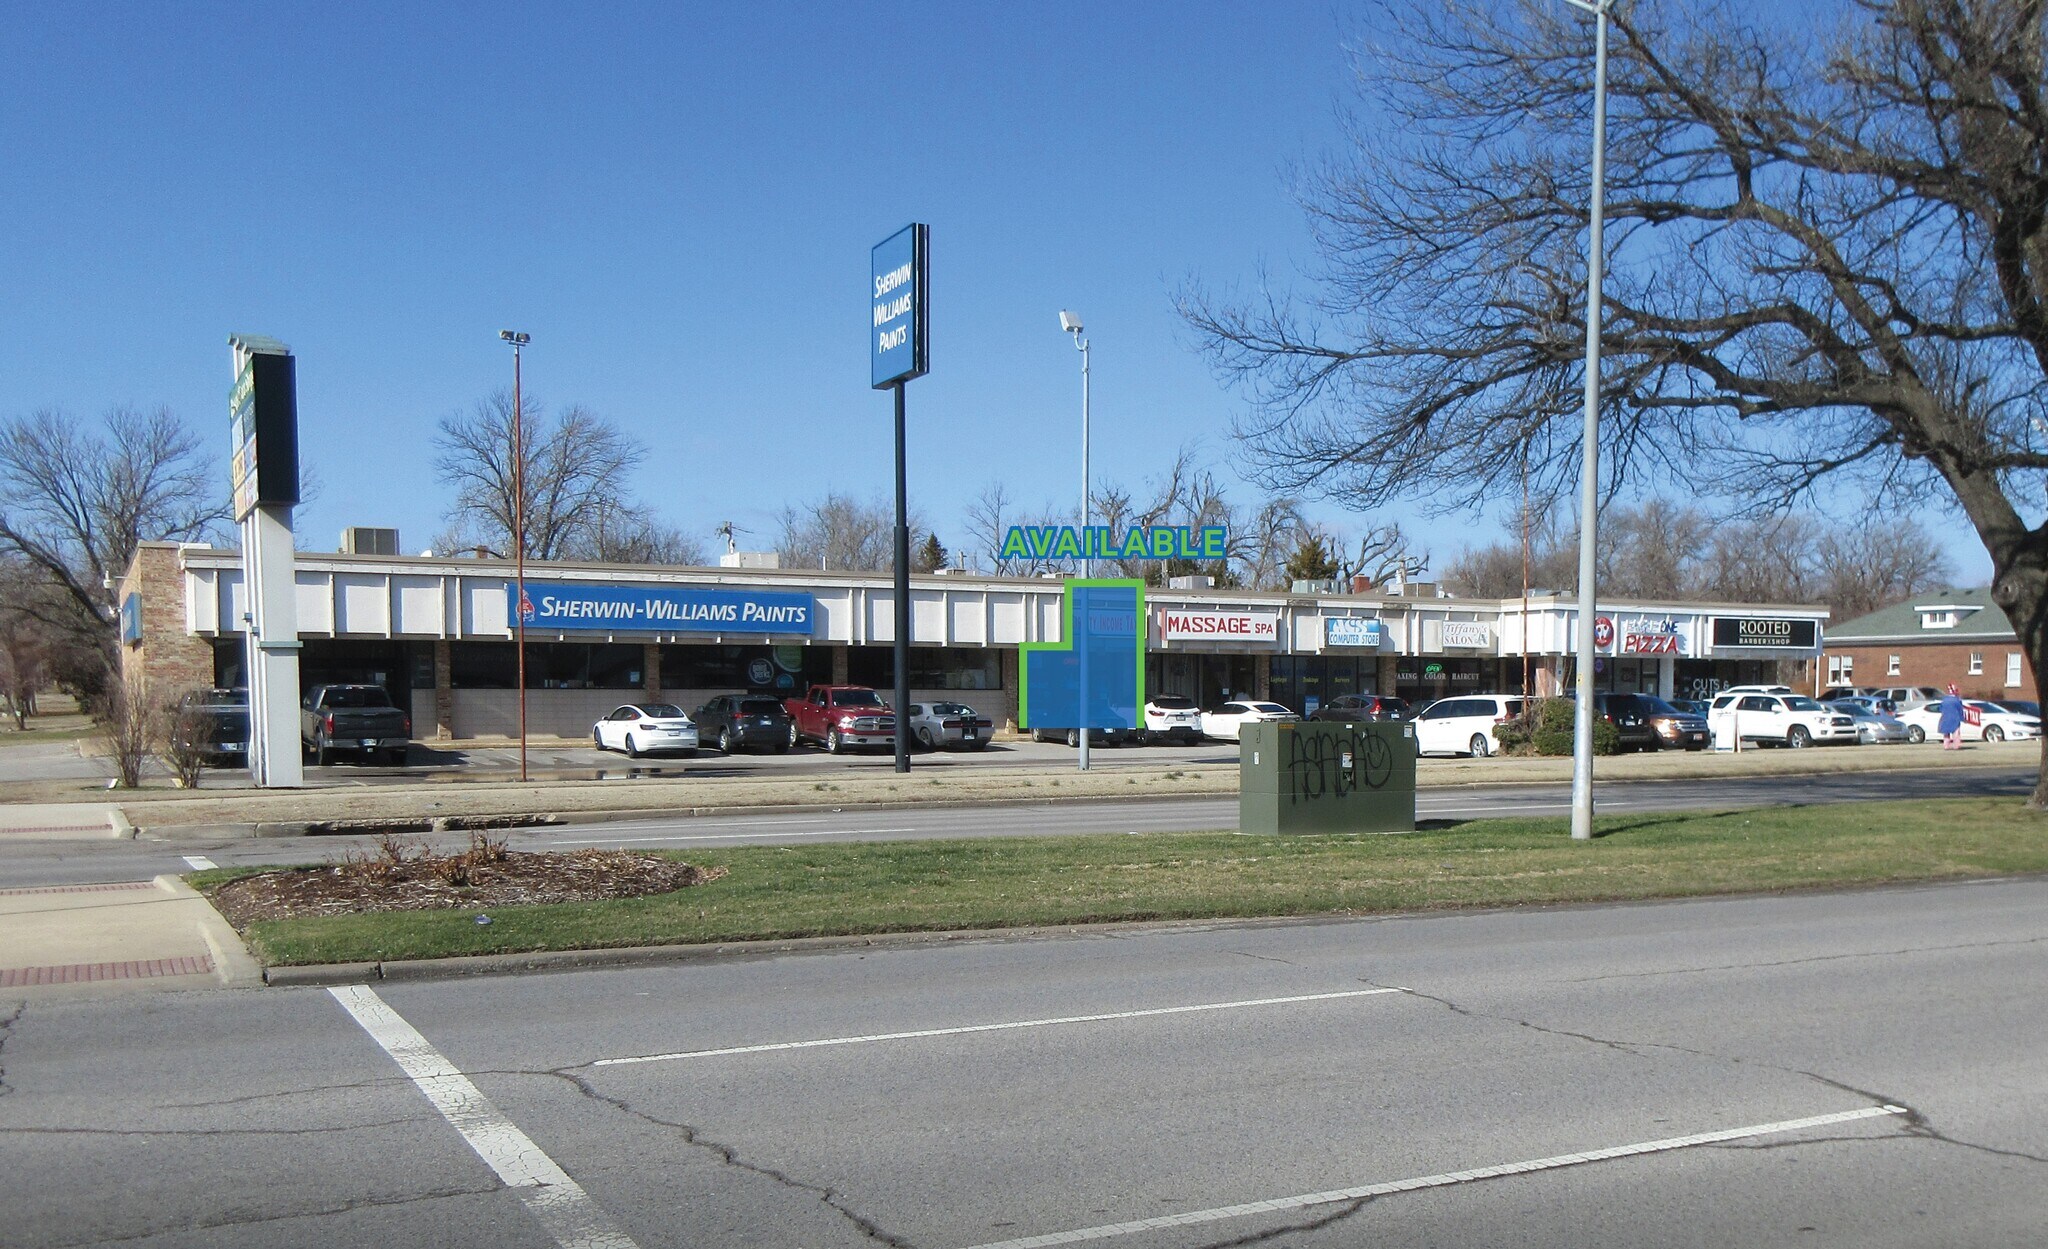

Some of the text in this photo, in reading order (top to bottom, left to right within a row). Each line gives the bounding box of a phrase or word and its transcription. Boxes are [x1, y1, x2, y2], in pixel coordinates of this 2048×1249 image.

[874, 262, 912, 298] SHERWIN
[873, 292, 912, 328] WILLIAMS
[878, 324, 907, 354] PAINTS
[539, 596, 737, 622] SHERWIN-WILLIAMS
[742, 602, 807, 623] PAINTS
[1125, 614, 1136, 632] TA
[1168, 616, 1274, 634] MASSAGE SPA
[1443, 623, 1488, 636] Tiffany's
[1739, 620, 1791, 634] ROOTED
[1329, 633, 1379, 645] COMPUTER STORE
[1444, 635, 1473, 645] SALON
[1624, 633, 1679, 654] PIZZA
[1424, 672, 1447, 680] COLOR
[1452, 672, 1480, 680] HAIRCUT
[1692, 678, 1720, 691] CUTS
